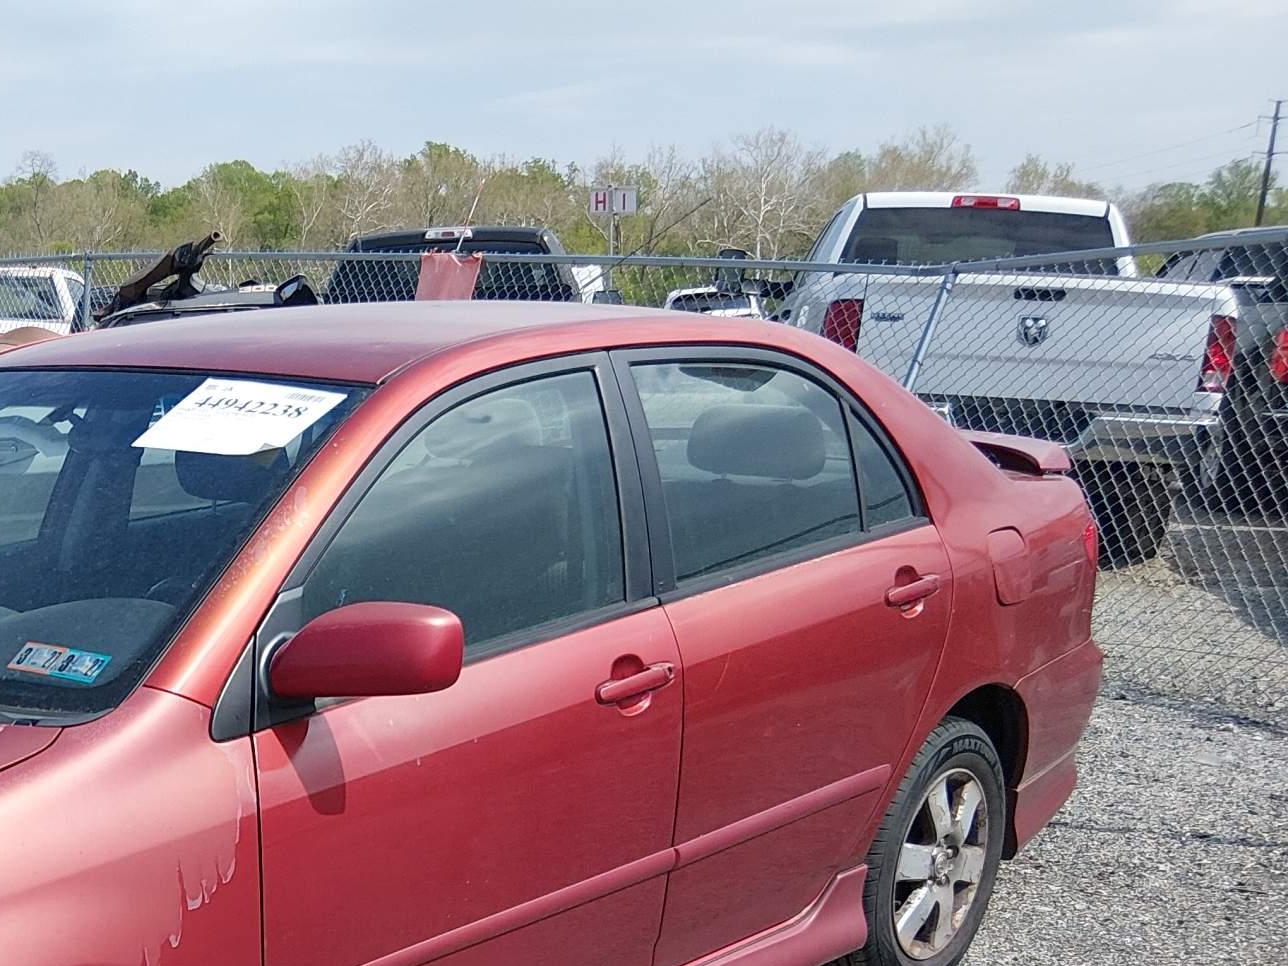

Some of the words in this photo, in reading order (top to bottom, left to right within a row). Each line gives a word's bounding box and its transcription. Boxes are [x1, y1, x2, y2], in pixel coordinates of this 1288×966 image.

[594, 191, 607, 211] H
[193, 395, 310, 420] 44942238
[57, 653, 76, 672] 3
